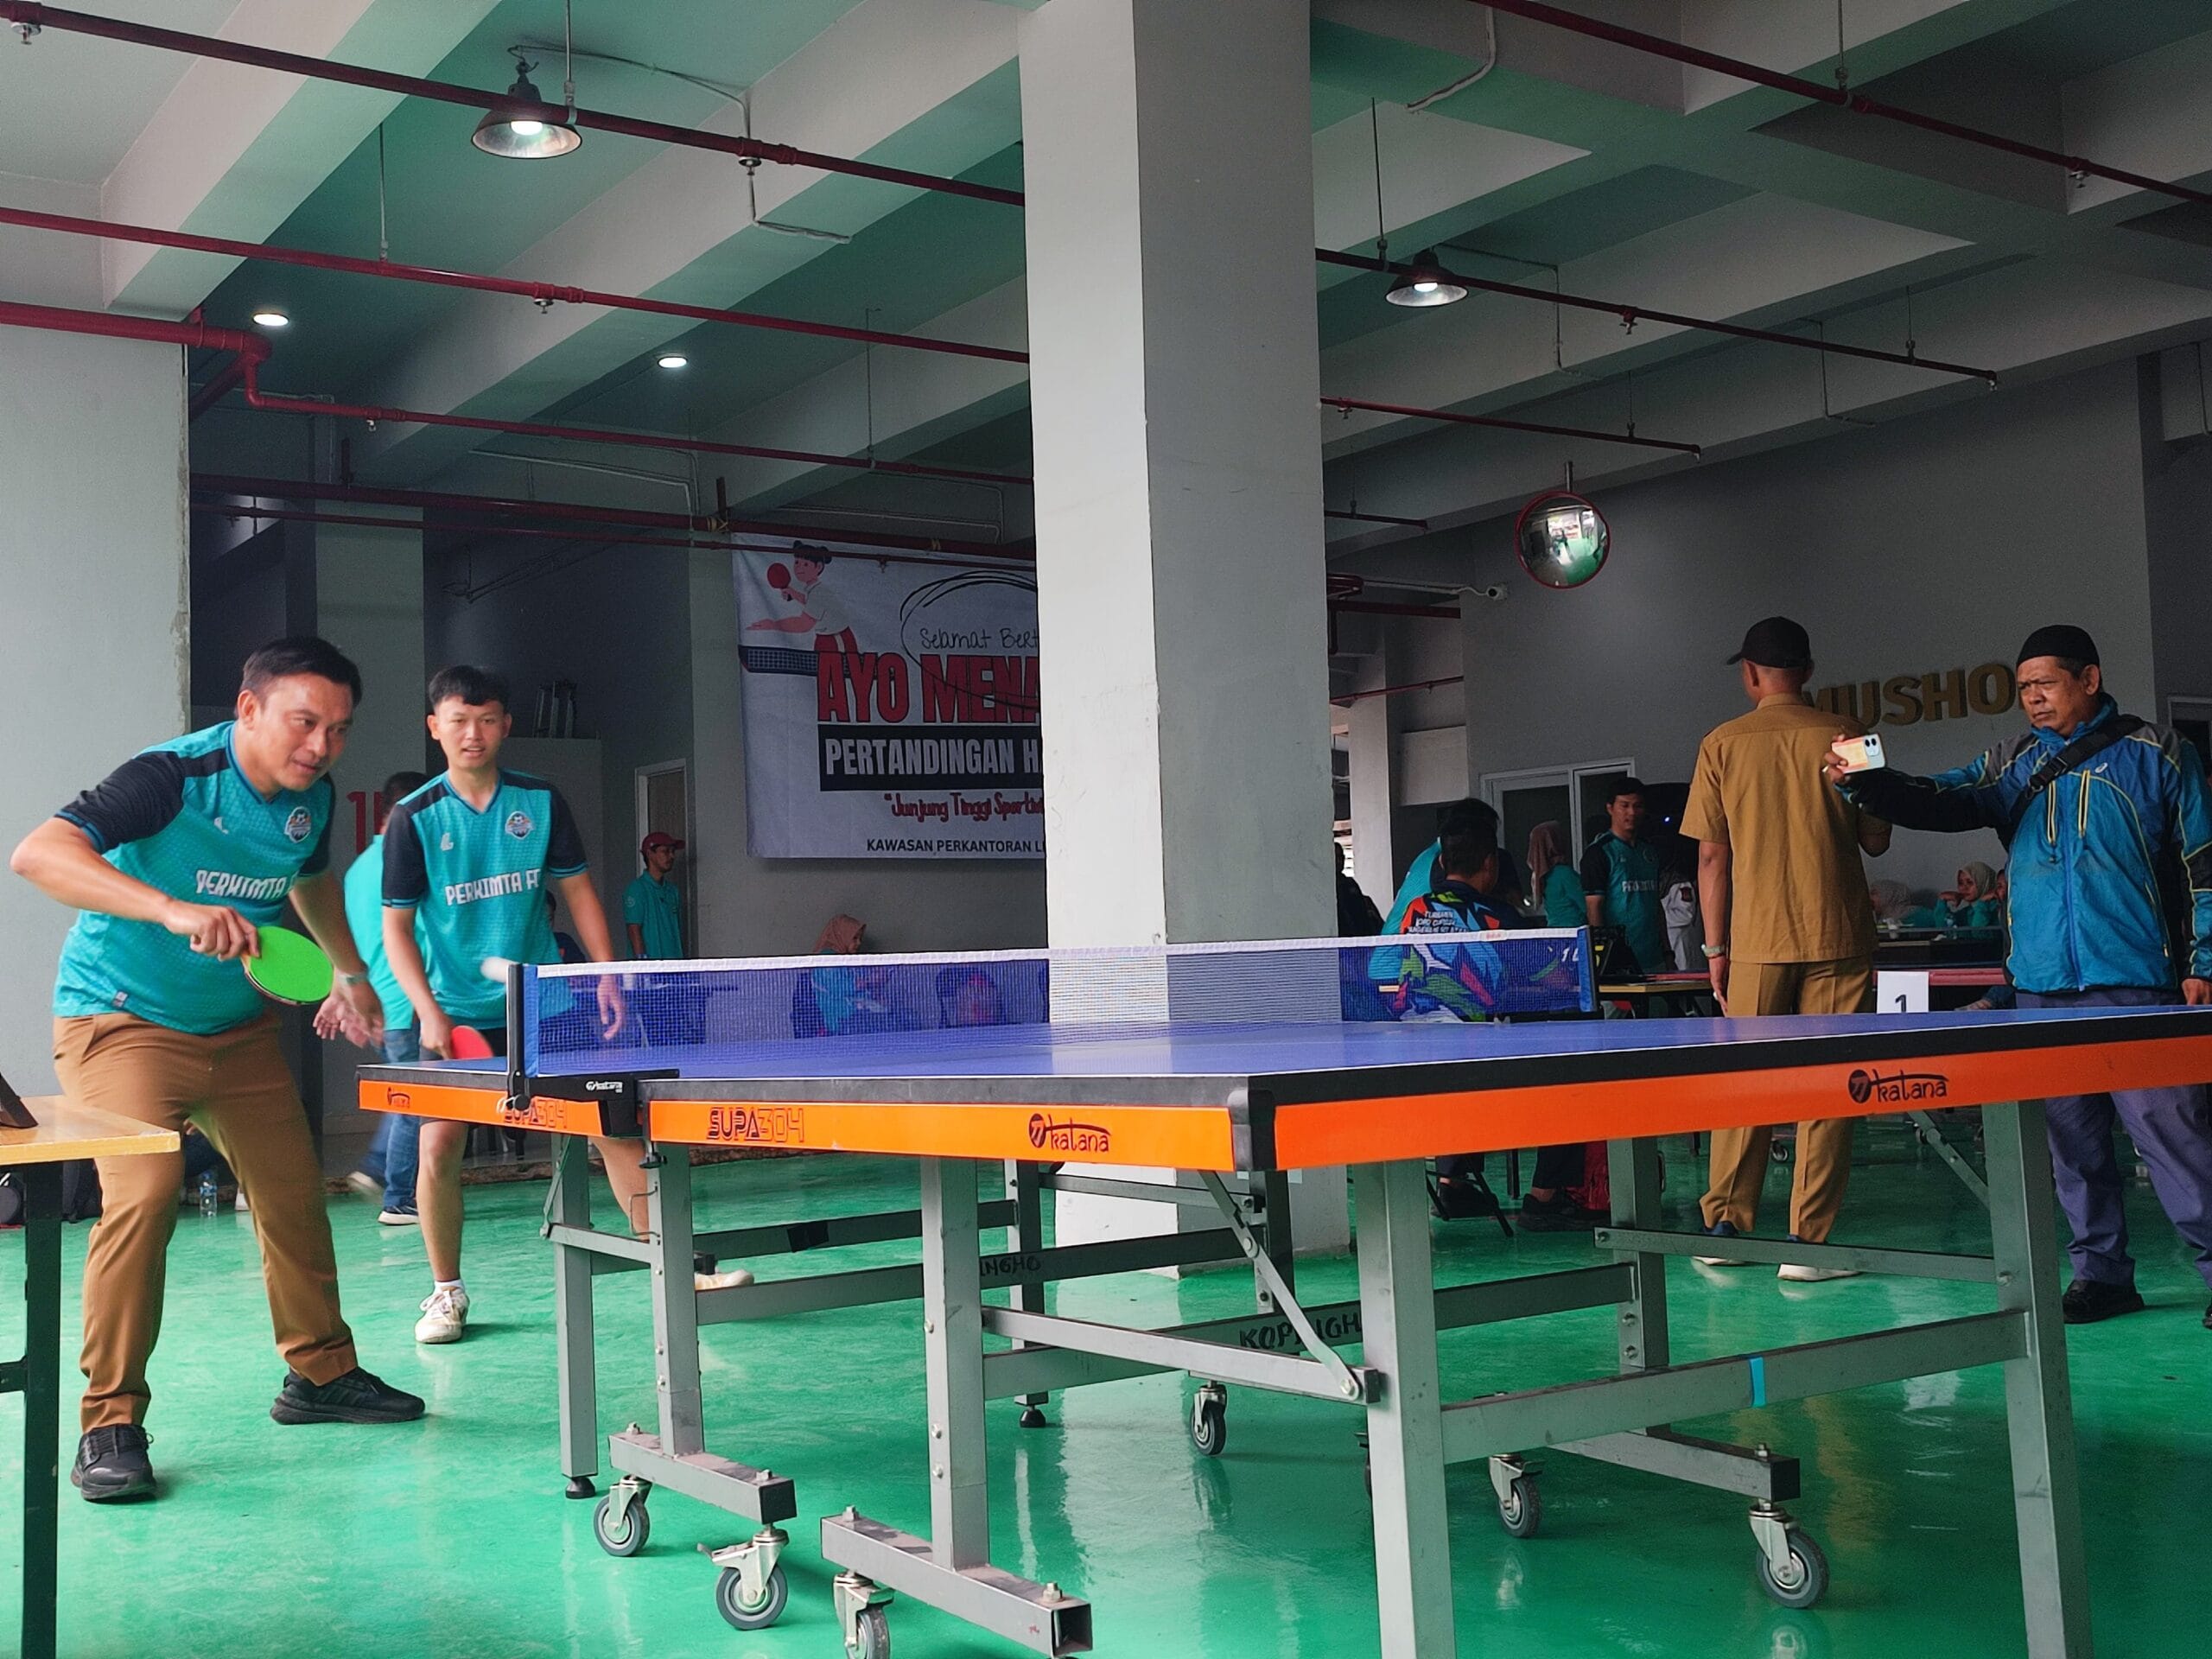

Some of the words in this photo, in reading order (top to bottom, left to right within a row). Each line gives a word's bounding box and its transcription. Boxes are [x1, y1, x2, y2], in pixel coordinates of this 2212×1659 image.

[920, 627, 991, 648] Selamat
[817, 650, 910, 723] AYO
[825, 739, 1014, 775] PERTANDINGAN
[950, 791, 992, 822] Tinggi
[867, 839, 933, 852] KAWASAN
[936, 839, 1032, 853] PERKANTORAN
[444, 872, 523, 906] PERKIMTA
[1872, 1068, 1949, 1103] katana
[706, 1106, 804, 1143] SUPA304
[1048, 1113, 1110, 1153] katana
